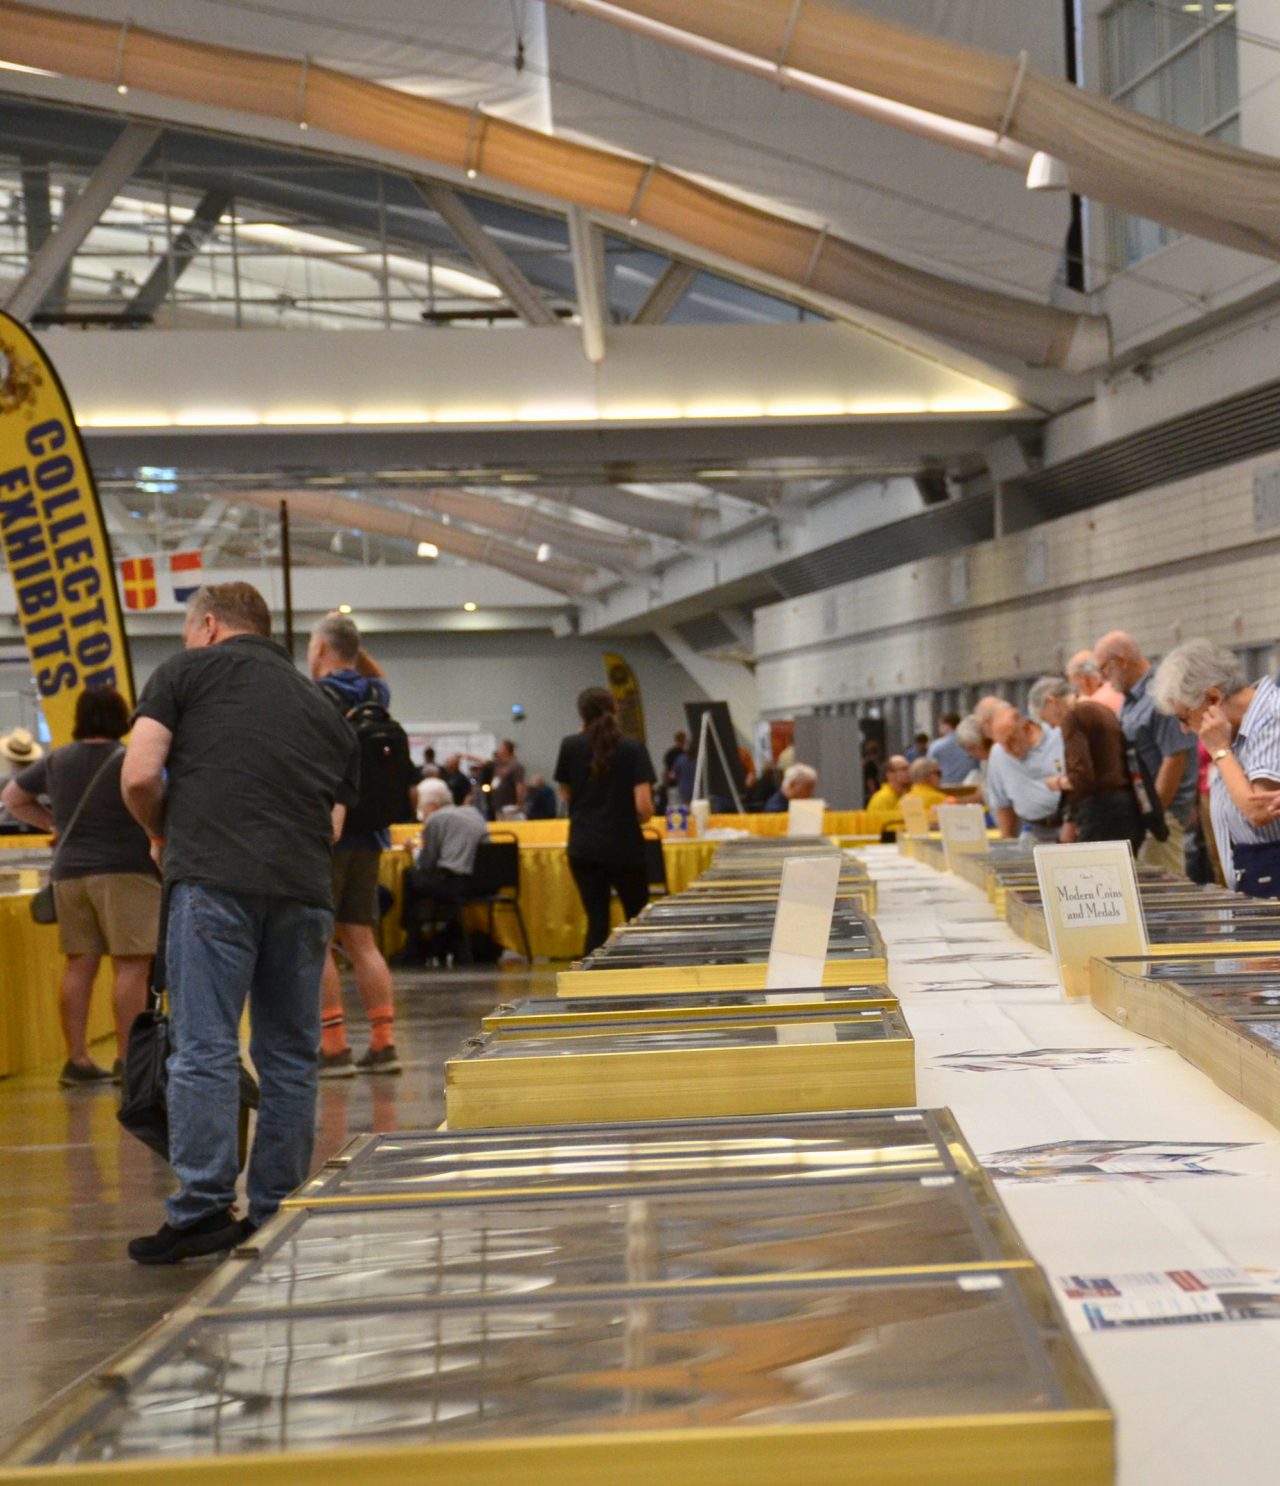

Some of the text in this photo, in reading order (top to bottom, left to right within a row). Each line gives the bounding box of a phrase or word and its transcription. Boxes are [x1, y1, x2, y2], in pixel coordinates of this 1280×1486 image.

[1056, 883, 1122, 902] Modern Coins
[1067, 902, 1120, 920] and Medals
